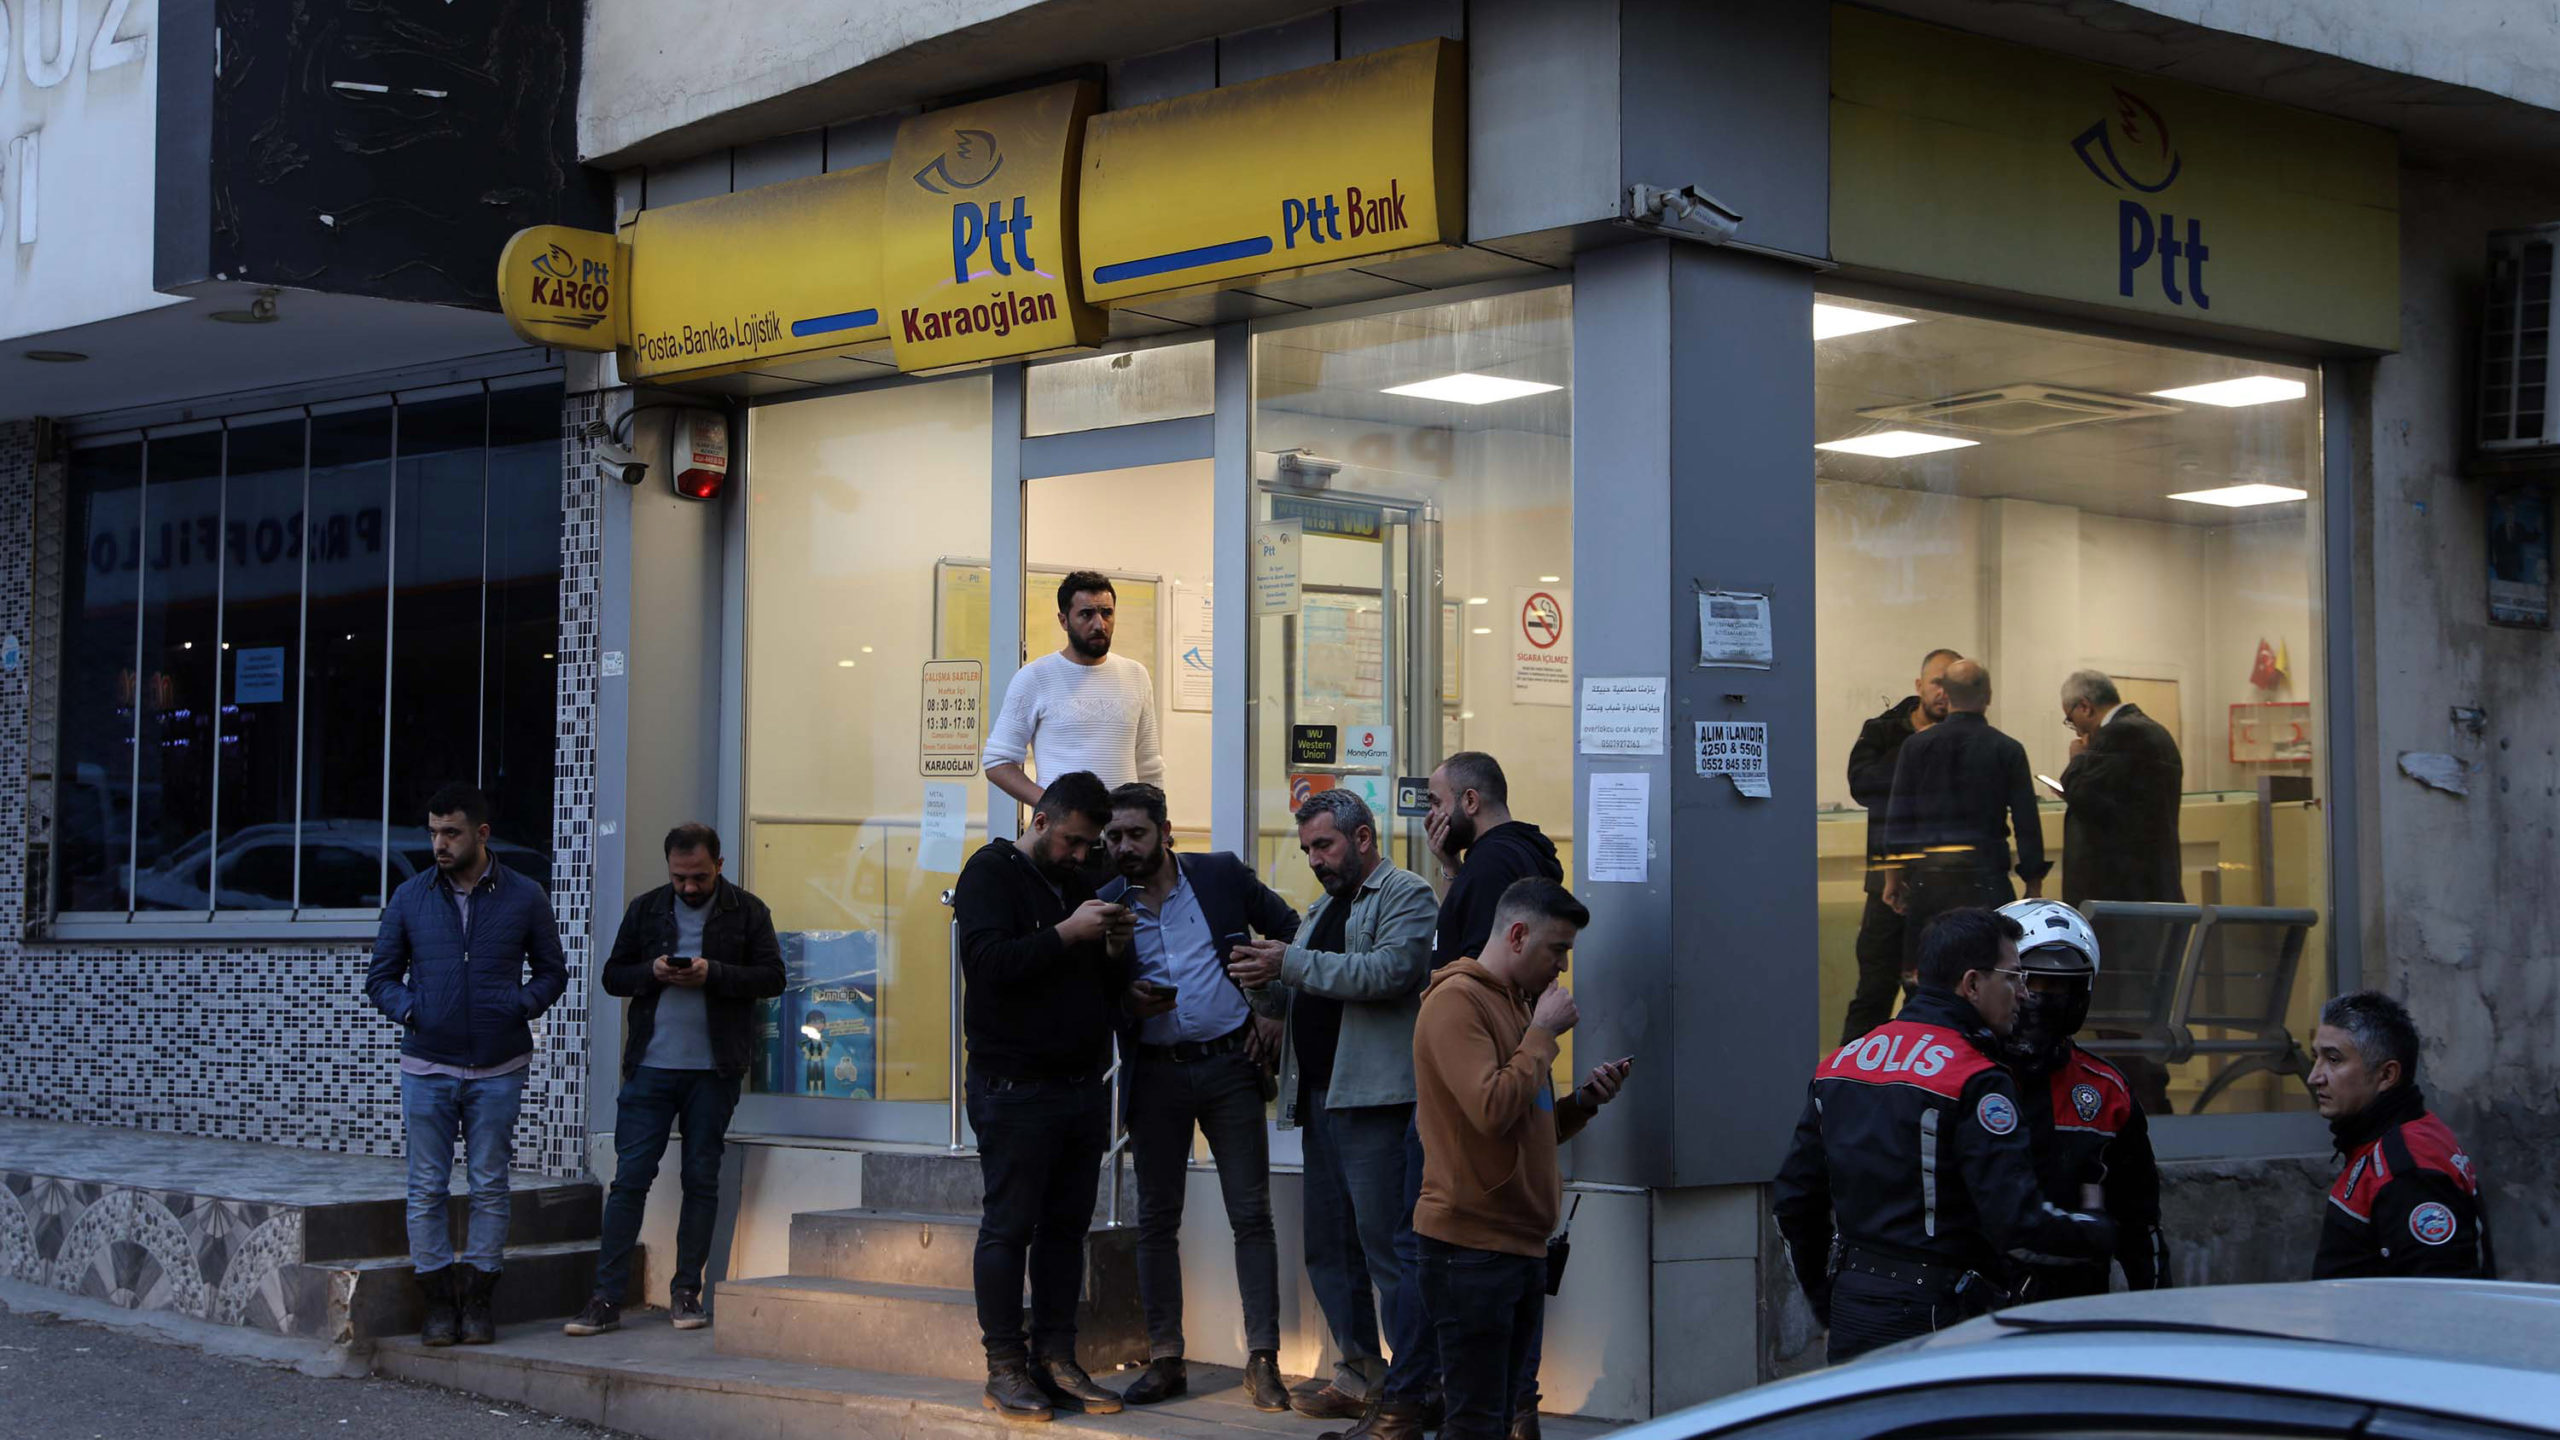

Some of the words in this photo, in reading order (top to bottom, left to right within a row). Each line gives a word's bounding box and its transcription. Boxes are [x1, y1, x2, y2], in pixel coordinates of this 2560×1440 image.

[1282, 194, 1342, 249] Ptt
[1347, 179, 1408, 238] Bank
[953, 196, 1035, 284] Ptt
[2119, 199, 2209, 310] Ptt
[582, 258, 609, 286] Ptt
[531, 276, 609, 312] KARGO
[901, 291, 1057, 343] Karaoğlan
[637, 331, 679, 362] Posta
[683, 321, 730, 355] Banka
[735, 310, 783, 353] Lojistik
[1304, 516, 1336, 531] NION
[1263, 545, 1276, 557] Ptt
[1701, 726, 1724, 743] ALIM
[1297, 739, 1332, 749] Western
[1701, 742, 1727, 756] 4250
[1730, 742, 1737, 754] &
[1740, 743, 1762, 757] 5500
[1302, 749, 1326, 759] Union
[1346, 749, 1388, 758] MoneyGram
[925, 758, 974, 771] KARAOĞLAN
[1701, 758, 1724, 771] 0552
[1725, 758, 1740, 771] 845
[1741, 758, 1751, 771] 58
[1752, 758, 1763, 771] 97
[1831, 1034, 1955, 1077] POLİS
